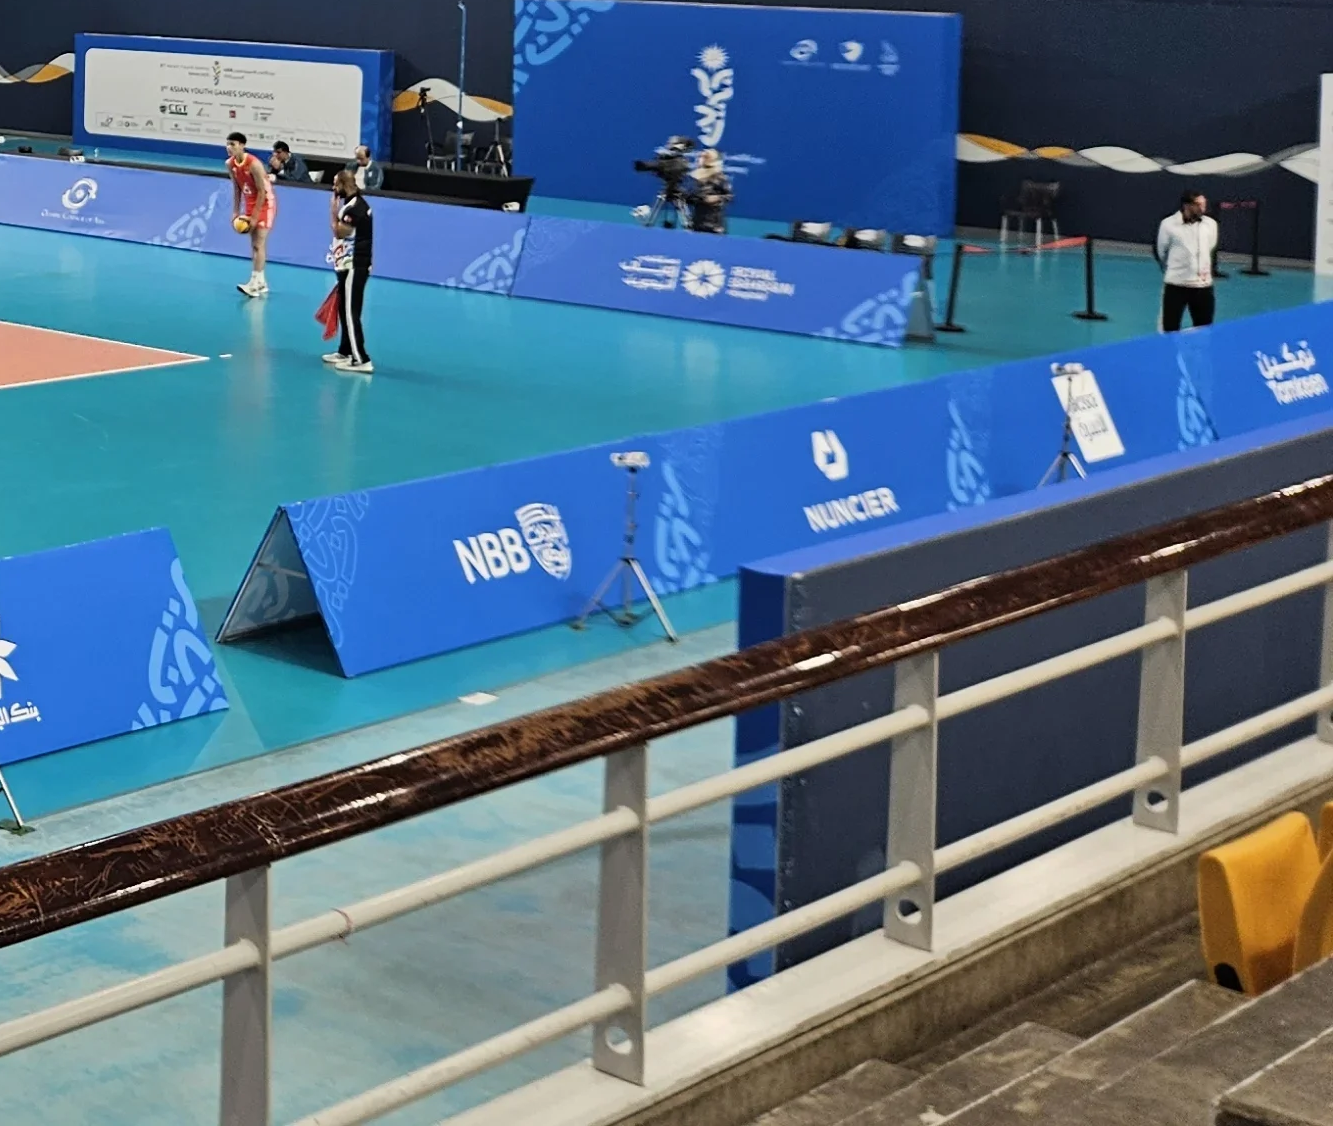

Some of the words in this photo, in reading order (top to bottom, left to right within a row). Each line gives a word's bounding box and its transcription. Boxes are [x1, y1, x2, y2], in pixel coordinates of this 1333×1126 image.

[170, 86, 189, 94] ASIAN
[190, 87, 213, 95] YOUTH
[214, 88, 237, 97] GAMES
[238, 90, 274, 100] SPONSORS
[1253, 340, 1316, 380] تمكين
[1265, 373, 1330, 405] Tamkeen
[802, 486, 902, 534] NUNCIER
[452, 527, 531, 585] NBB
[10, 701, 42, 722] بنك
